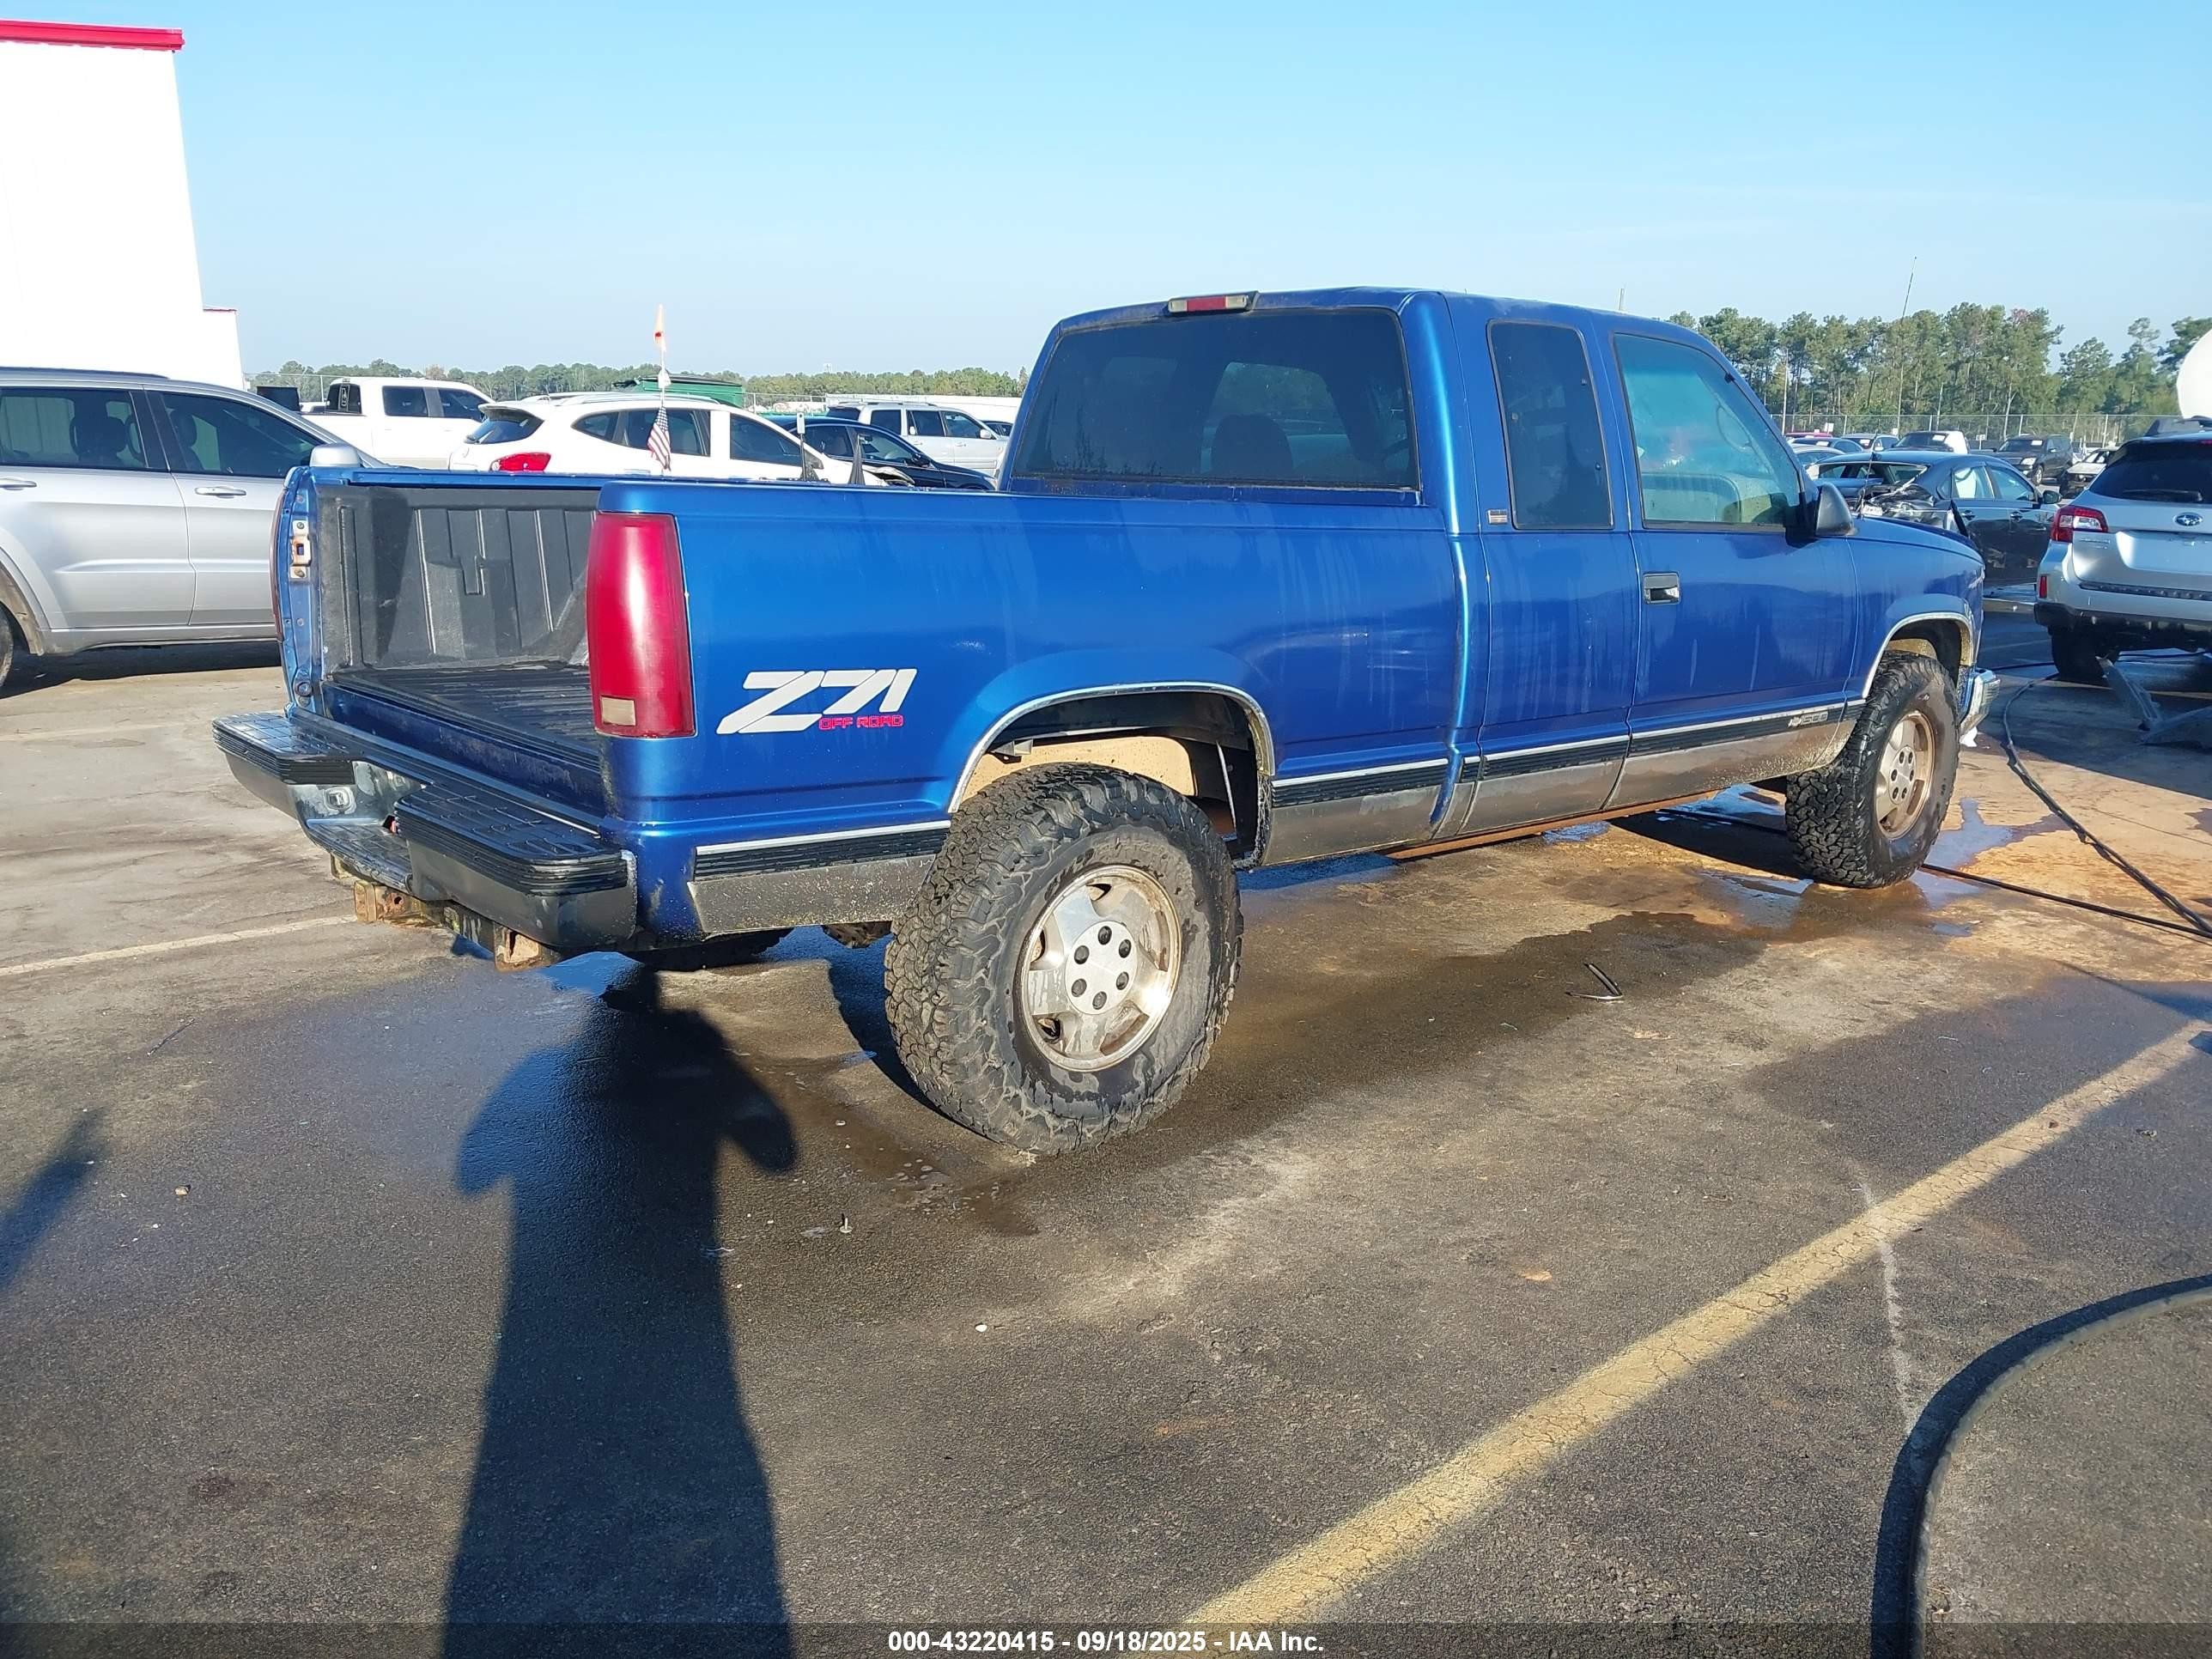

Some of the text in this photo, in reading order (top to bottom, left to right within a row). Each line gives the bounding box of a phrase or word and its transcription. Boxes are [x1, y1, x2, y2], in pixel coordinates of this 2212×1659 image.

[716, 668, 918, 734] Z71
[818, 714, 904, 731] OFF ROAD
